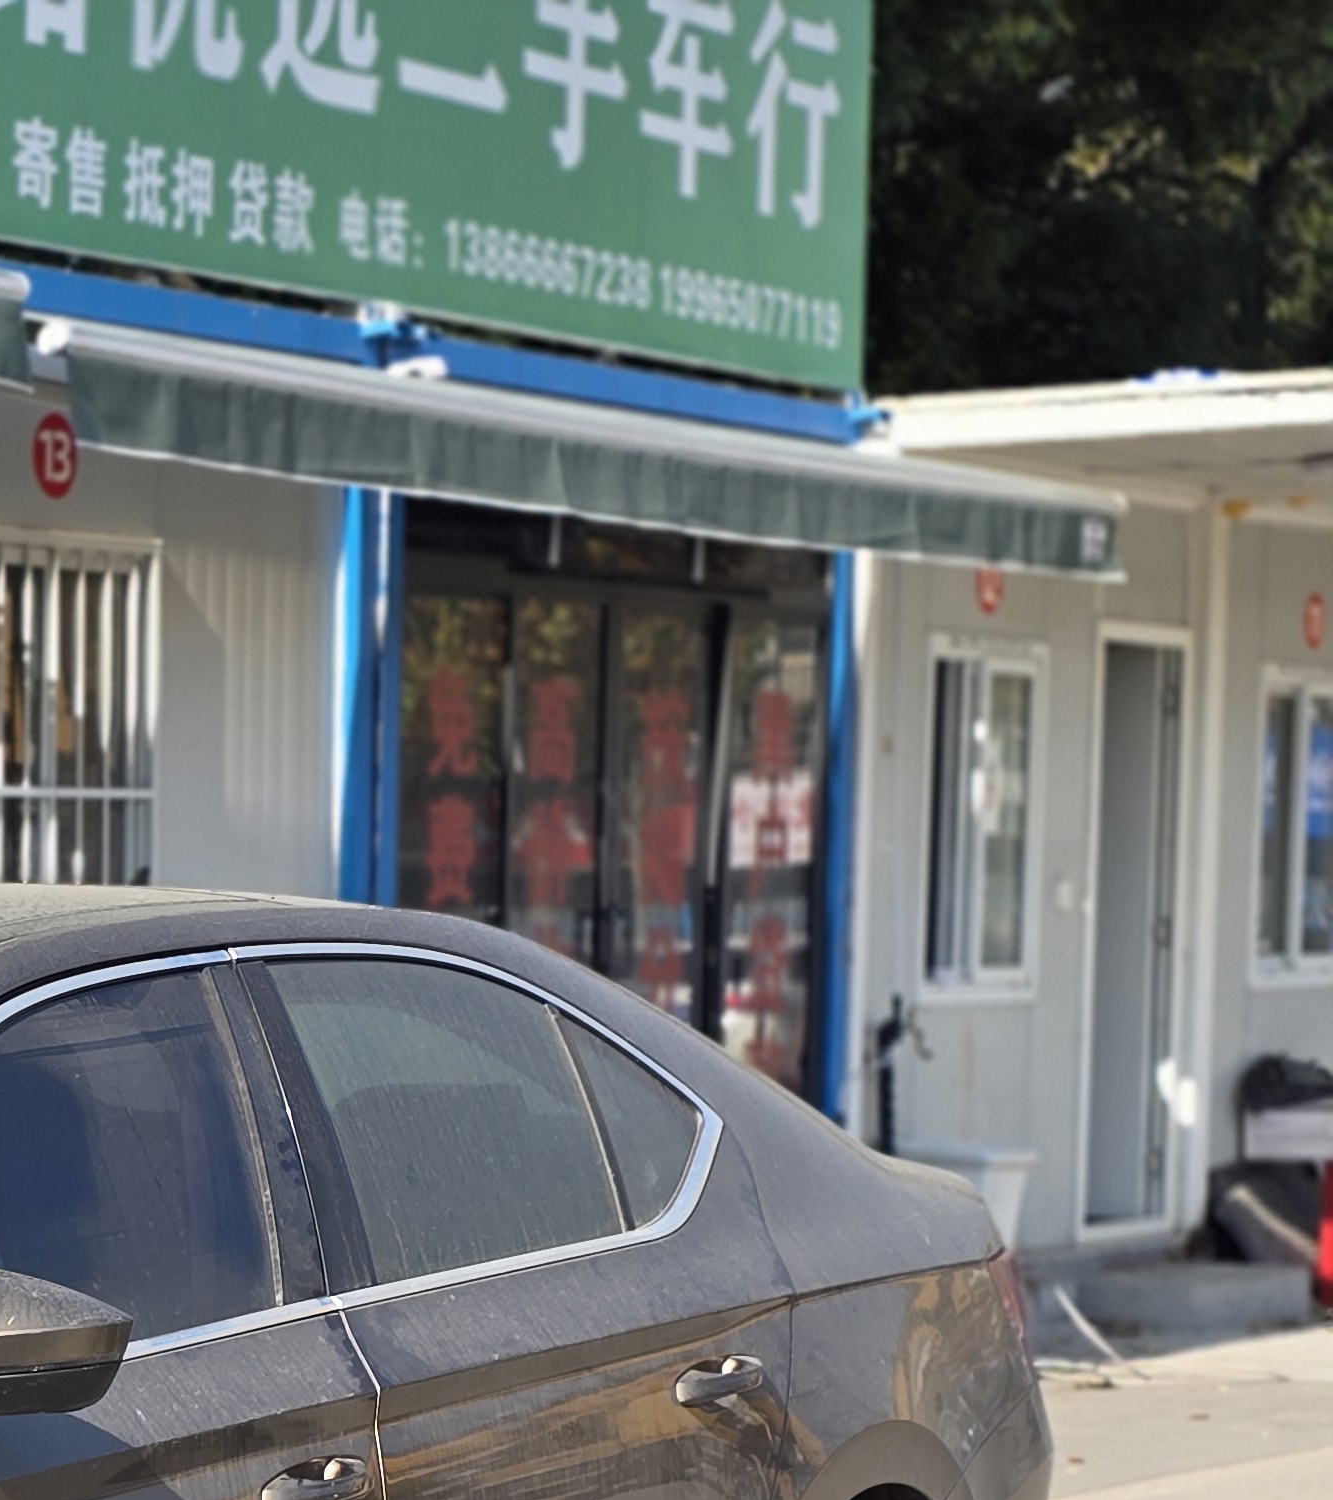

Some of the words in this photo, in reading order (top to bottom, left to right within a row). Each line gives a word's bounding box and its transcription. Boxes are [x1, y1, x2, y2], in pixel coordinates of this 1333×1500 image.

[13, 118, 107, 218] 寄售
[124, 138, 214, 237] 抵押
[229, 160, 314, 254] 贷款
[38, 429, 72, 483] 13
